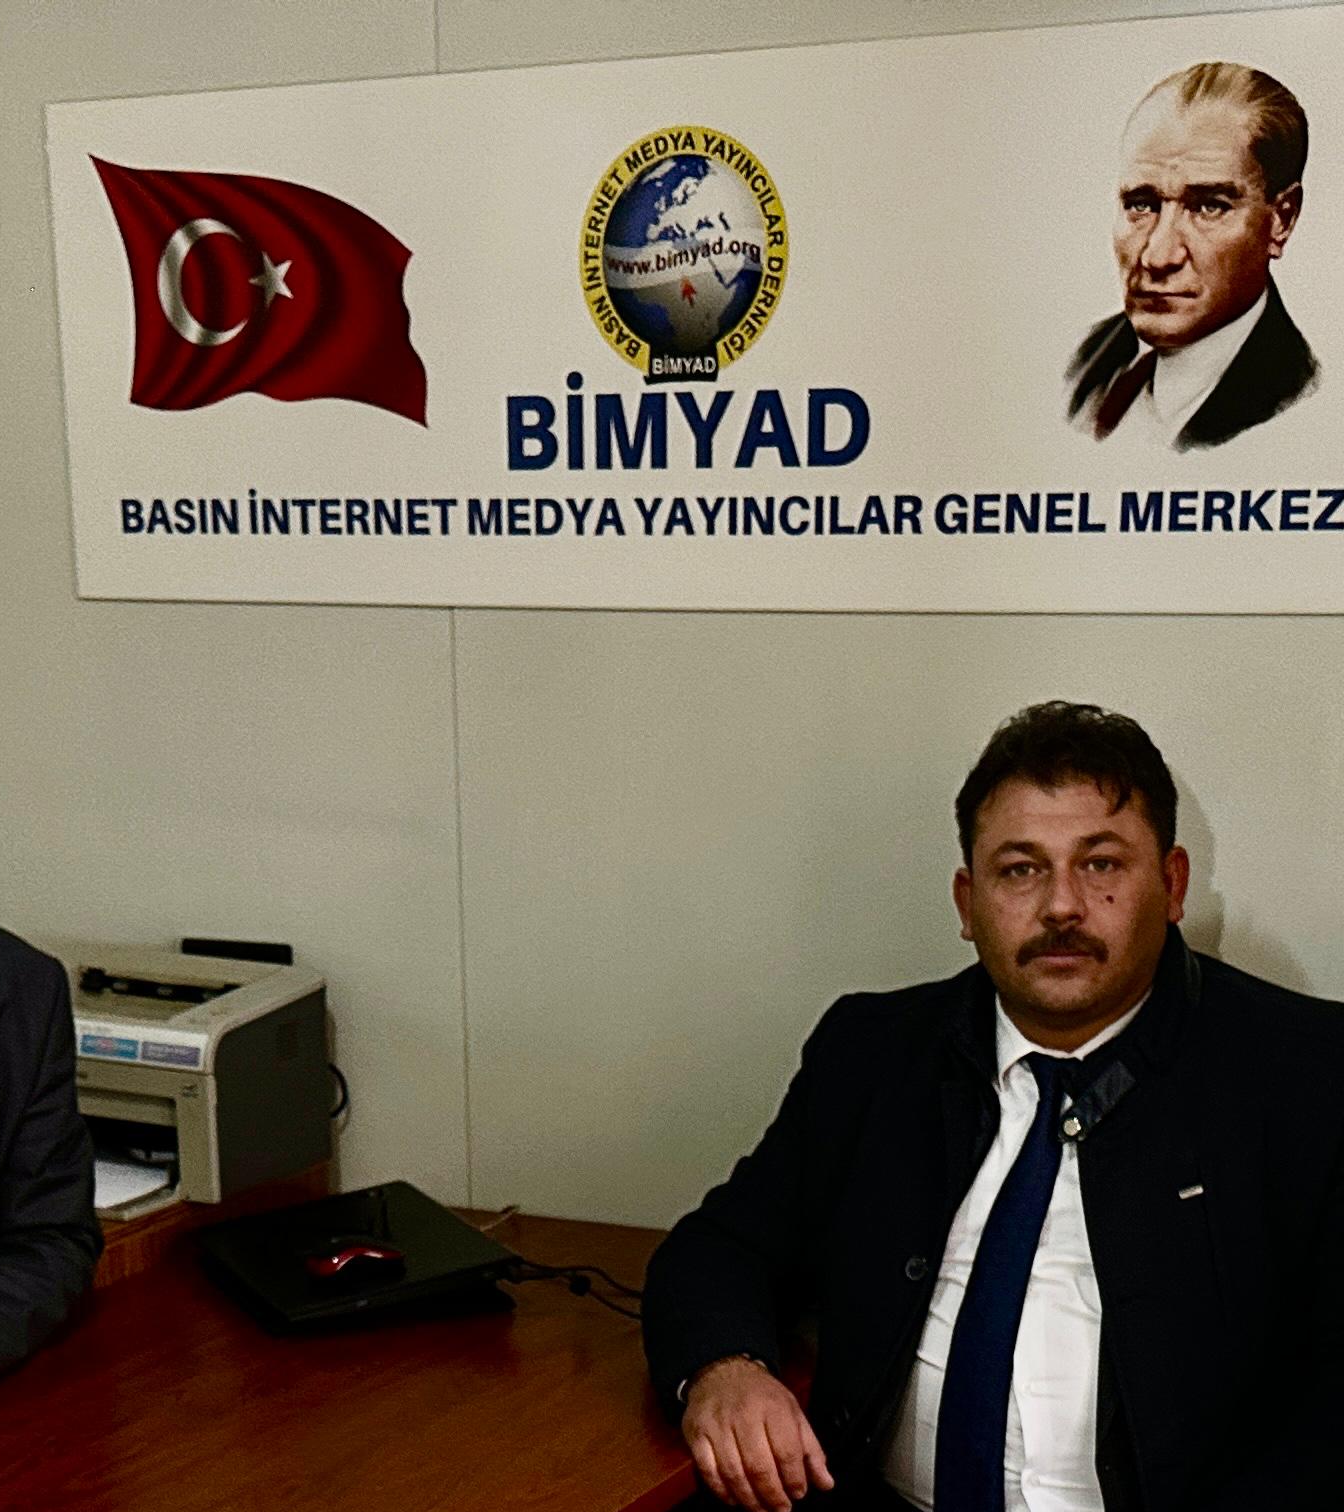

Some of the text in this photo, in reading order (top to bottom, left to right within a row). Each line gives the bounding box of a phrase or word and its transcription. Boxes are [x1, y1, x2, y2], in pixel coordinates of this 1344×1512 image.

[592, 295, 641, 359] BASIN
[624, 131, 696, 173] MEDYA
[703, 133, 784, 248] YAYINCILAR
[605, 236, 761, 275] www.bimyad.org
[651, 353, 717, 376] BİMYAD
[505, 371, 871, 471] BİMYAD
[121, 499, 239, 534] BASIN
[248, 489, 458, 535] İNTERNET
[468, 498, 626, 536] MEDYA
[636, 495, 922, 536] YAYINCILAR
[935, 492, 1106, 534] GENEL
